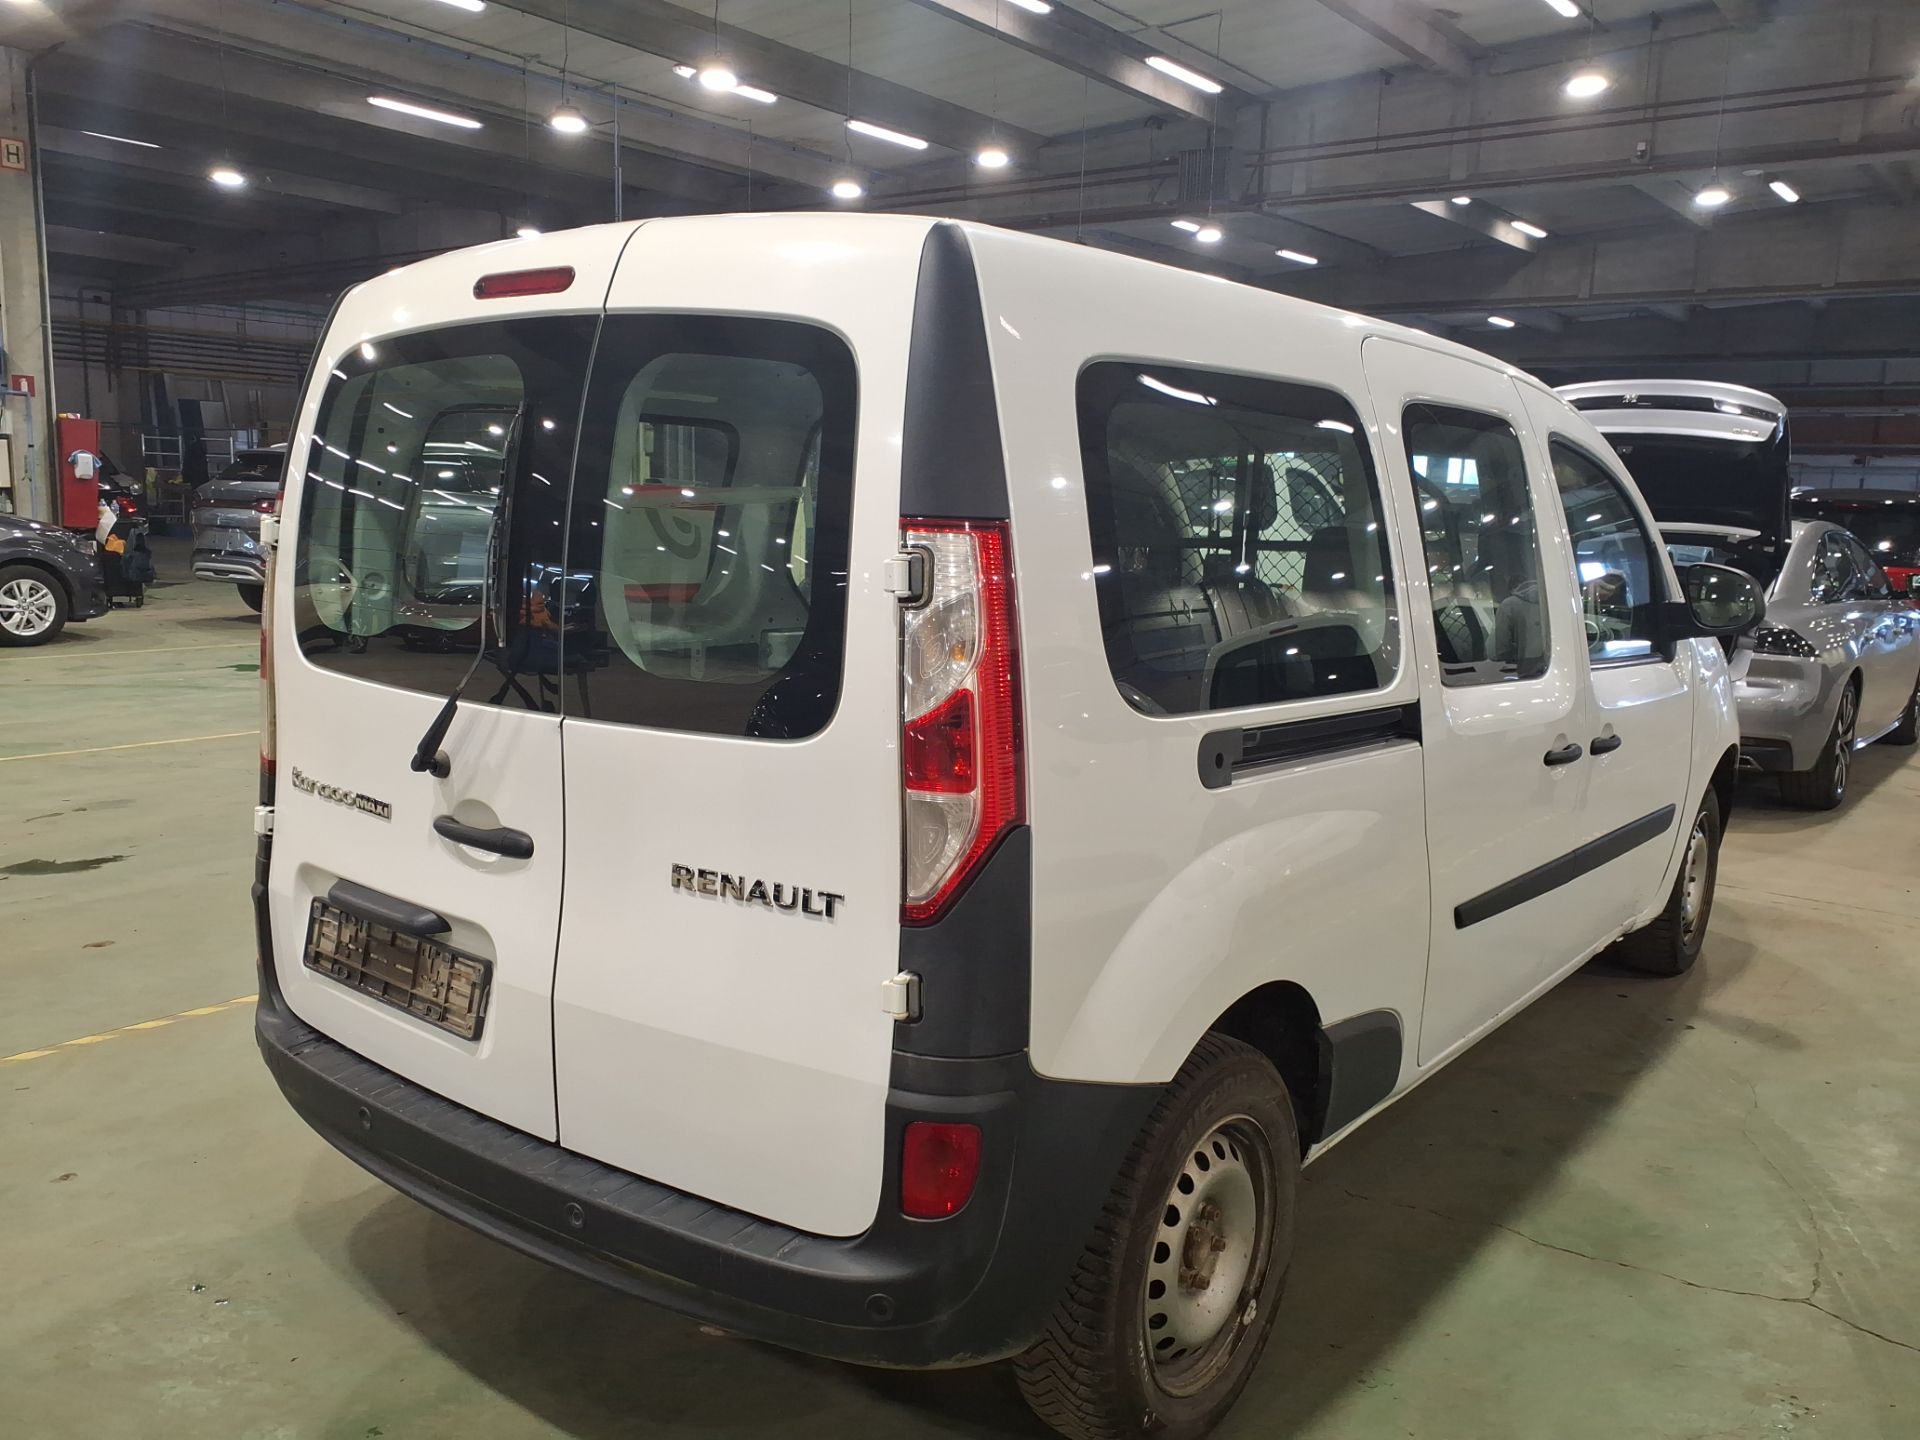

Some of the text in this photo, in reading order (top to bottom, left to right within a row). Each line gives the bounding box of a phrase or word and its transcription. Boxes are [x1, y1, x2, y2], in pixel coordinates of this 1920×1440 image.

[6, 144, 20, 164] H
[356, 794, 390, 819] MAXI
[672, 863, 845, 918] RENAULT
